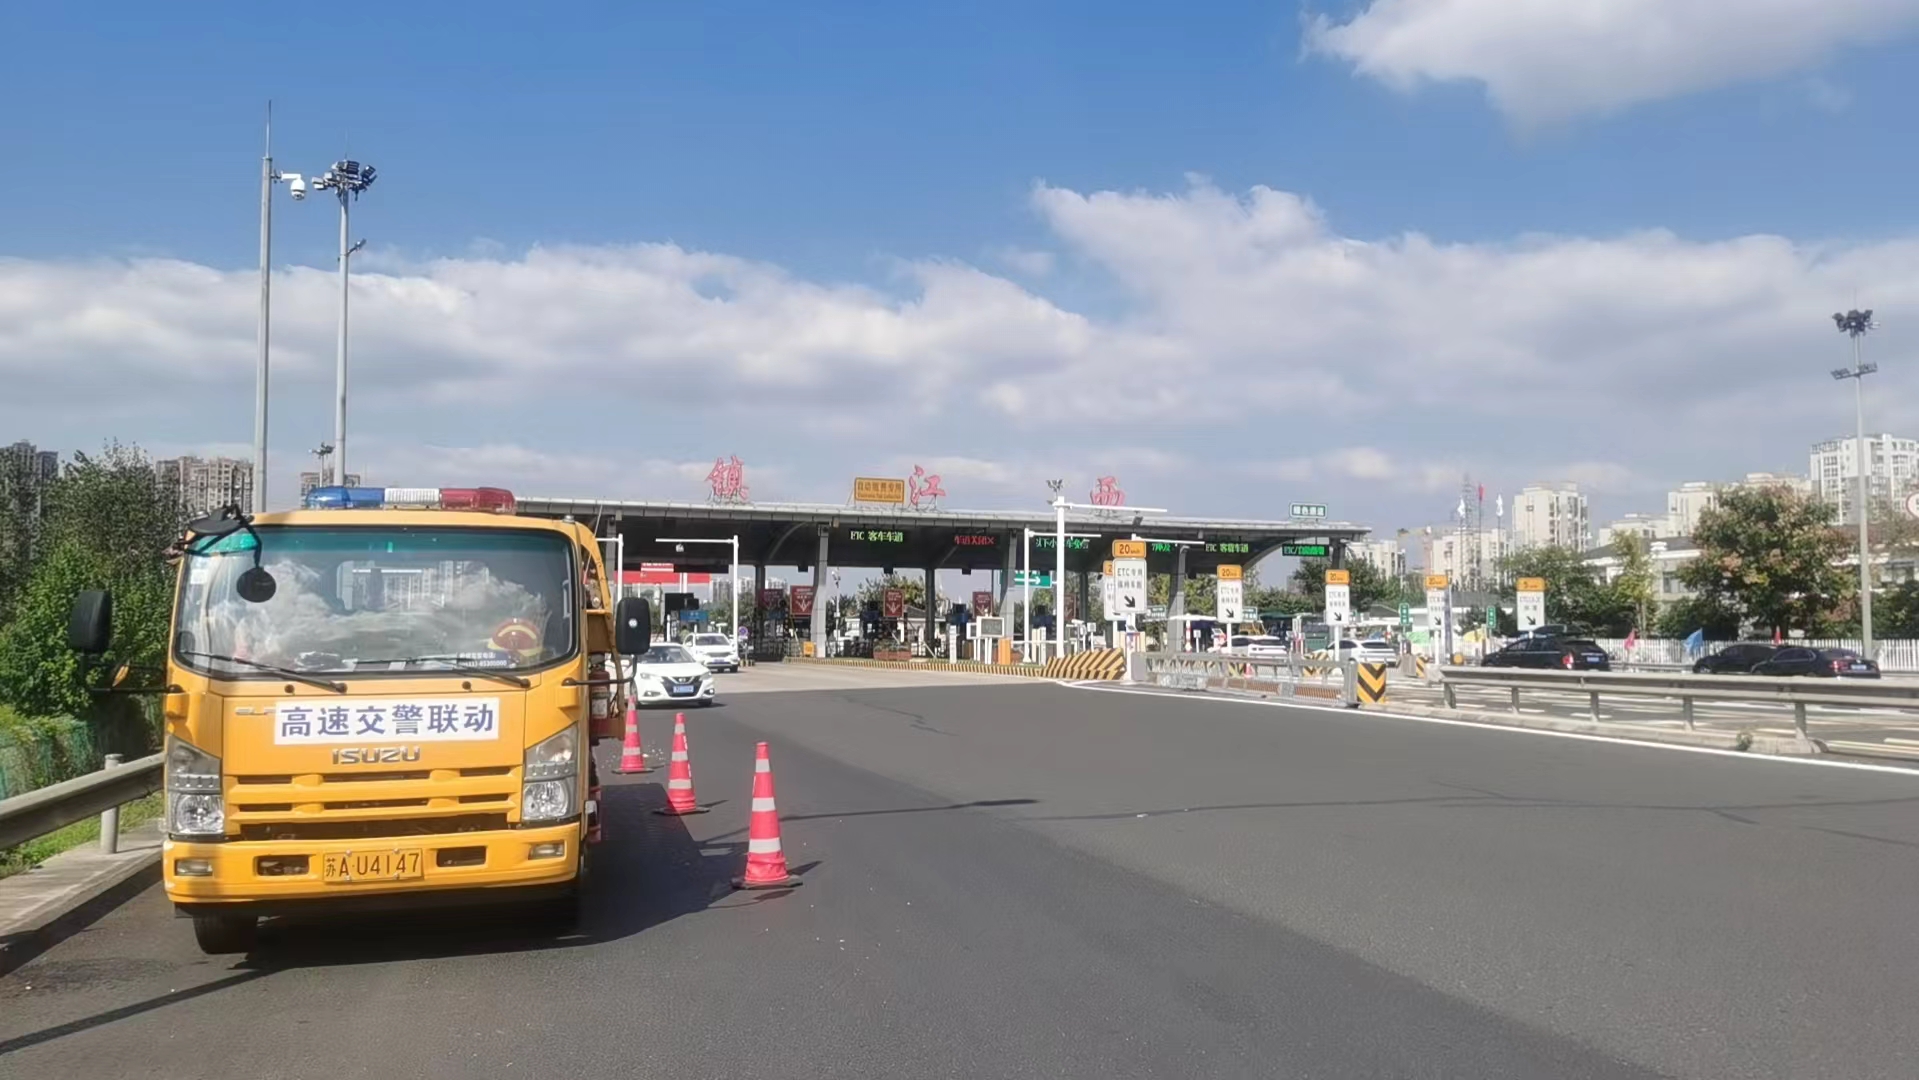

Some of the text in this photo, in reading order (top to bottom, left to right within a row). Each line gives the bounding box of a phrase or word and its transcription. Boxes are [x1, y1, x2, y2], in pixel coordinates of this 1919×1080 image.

[704, 455, 749, 500] 镇
[908, 464, 946, 505] 江
[850, 530, 865, 540] ETC
[1119, 544, 1130, 554] 20
[1222, 568, 1230, 577] 20
[280, 703, 494, 737] 高速交警联动
[332, 747, 421, 765] ISUZU
